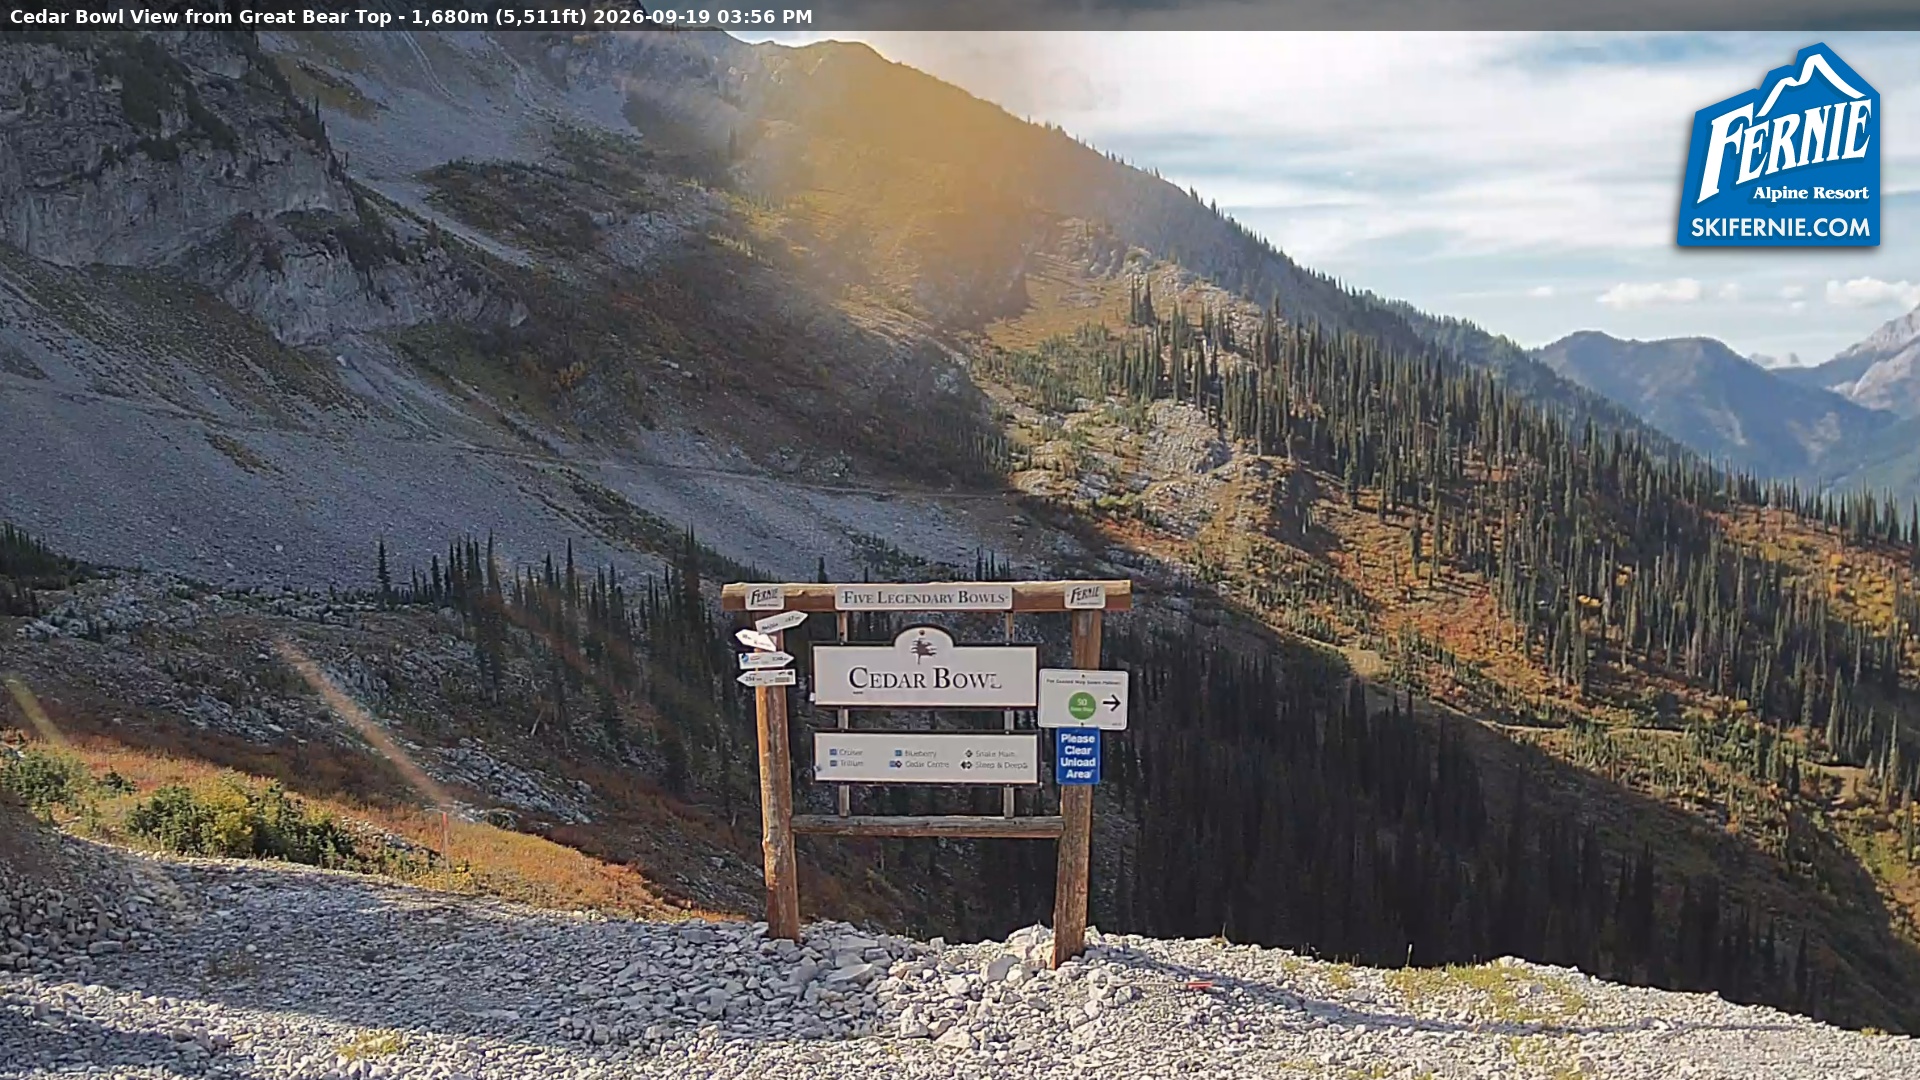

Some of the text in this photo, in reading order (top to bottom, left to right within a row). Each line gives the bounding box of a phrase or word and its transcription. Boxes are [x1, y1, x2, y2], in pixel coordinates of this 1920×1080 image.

[849, 667, 927, 689] CEDAR
[1060, 734, 1096, 743] Please
[1064, 746, 1092, 755] Clear
[1060, 758, 1096, 767] Unload
[1066, 769, 1093, 779] Area
